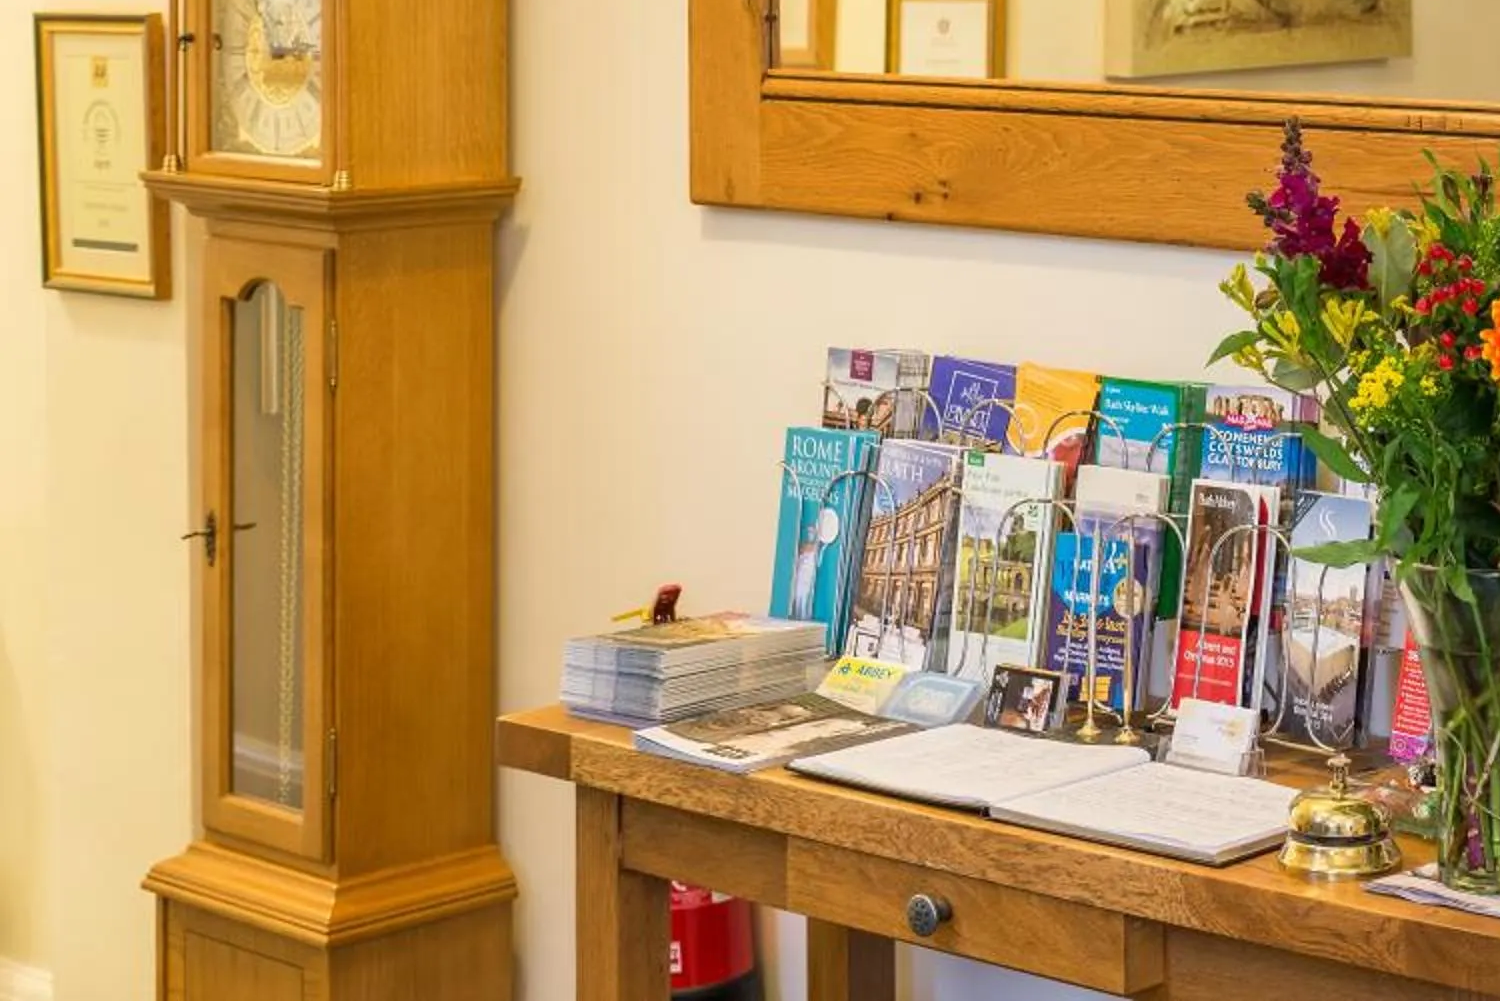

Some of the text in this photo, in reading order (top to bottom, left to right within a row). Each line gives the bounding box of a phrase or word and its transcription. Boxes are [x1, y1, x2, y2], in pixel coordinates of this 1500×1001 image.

[792, 435, 844, 463] ROME
[1207, 452, 1284, 471] GLATONBURY
[1196, 639, 1221, 652] Avent
